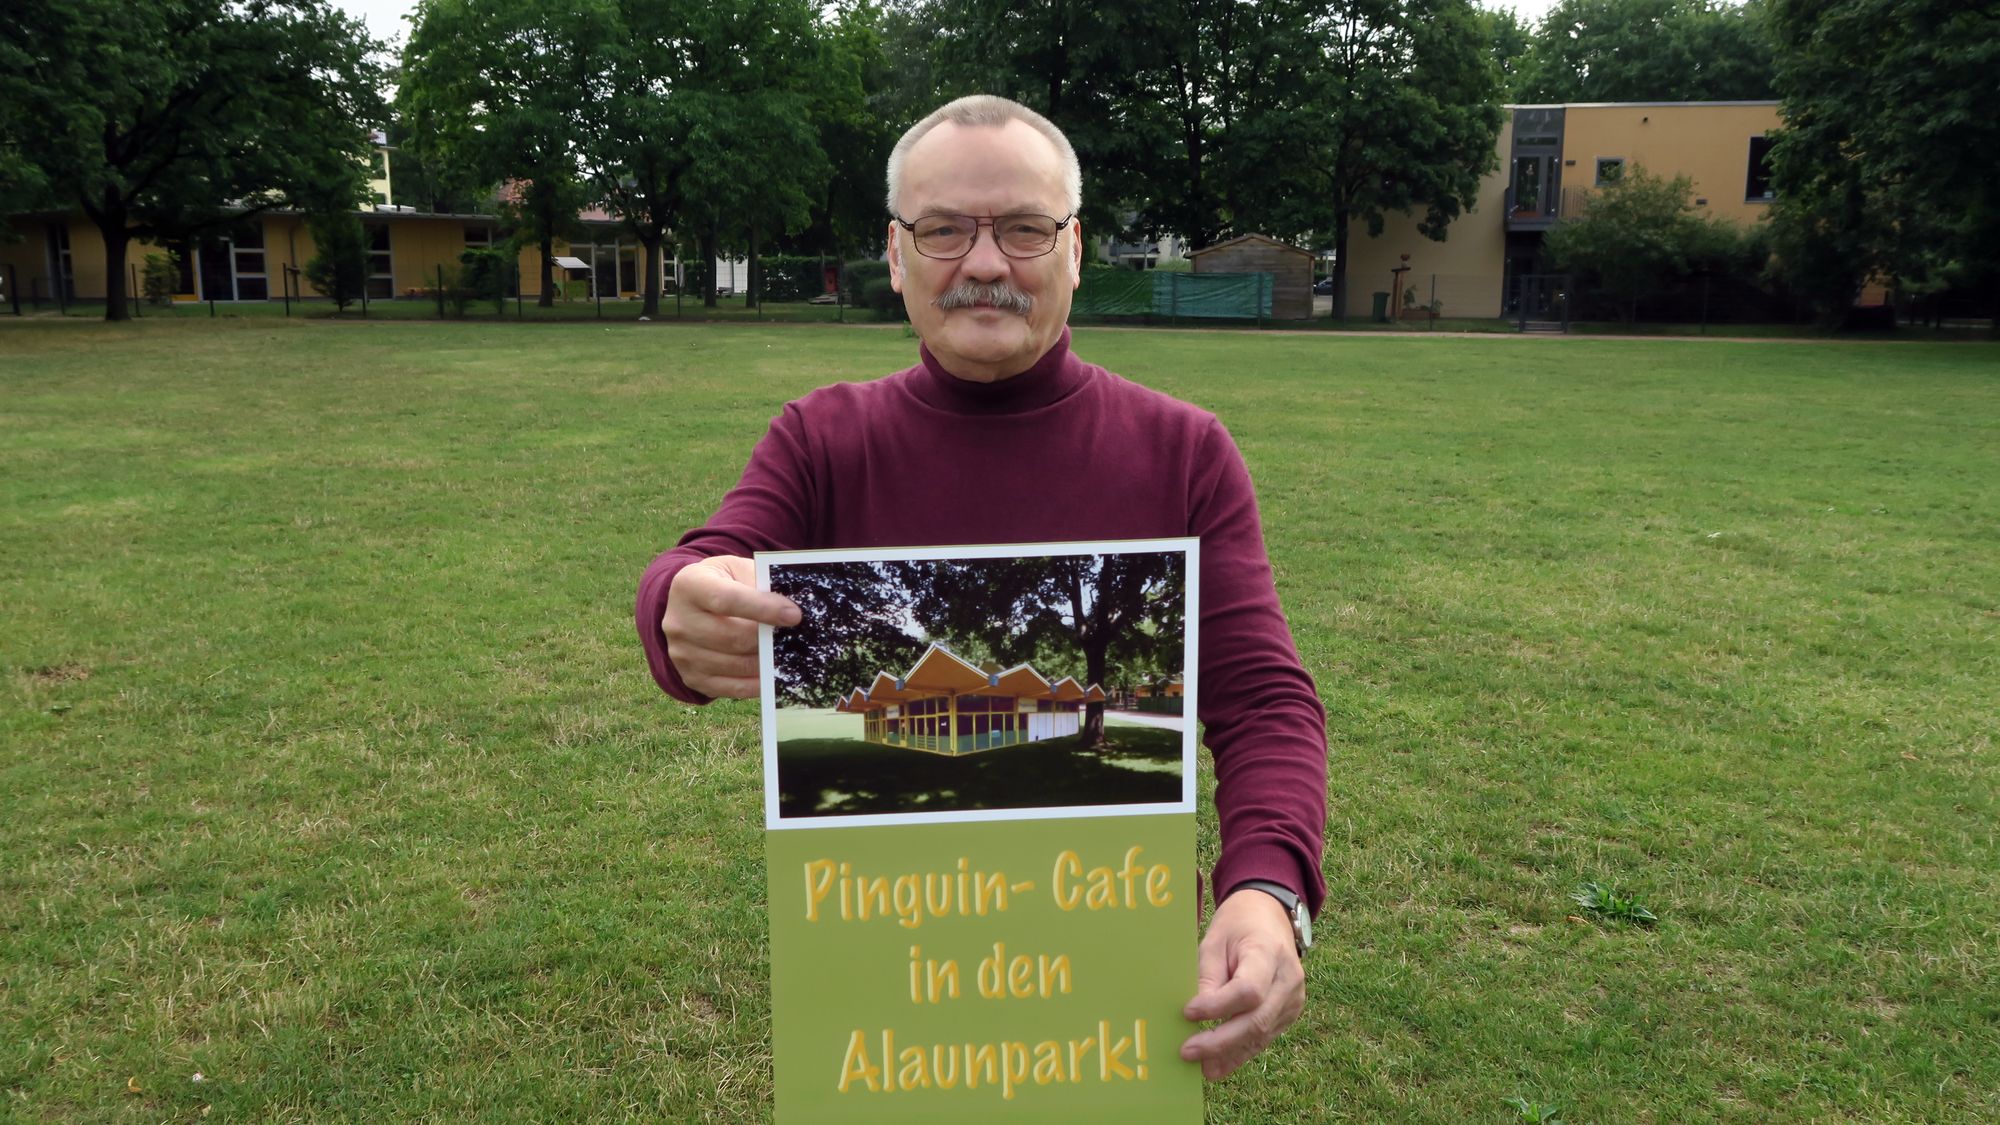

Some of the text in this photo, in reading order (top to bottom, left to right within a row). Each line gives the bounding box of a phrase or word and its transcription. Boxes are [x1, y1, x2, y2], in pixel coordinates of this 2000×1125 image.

[803, 845, 1175, 929] Pinguin- Cafe
[909, 942, 1074, 1004] in den
[837, 1018, 1150, 1101] Alaunpark!
